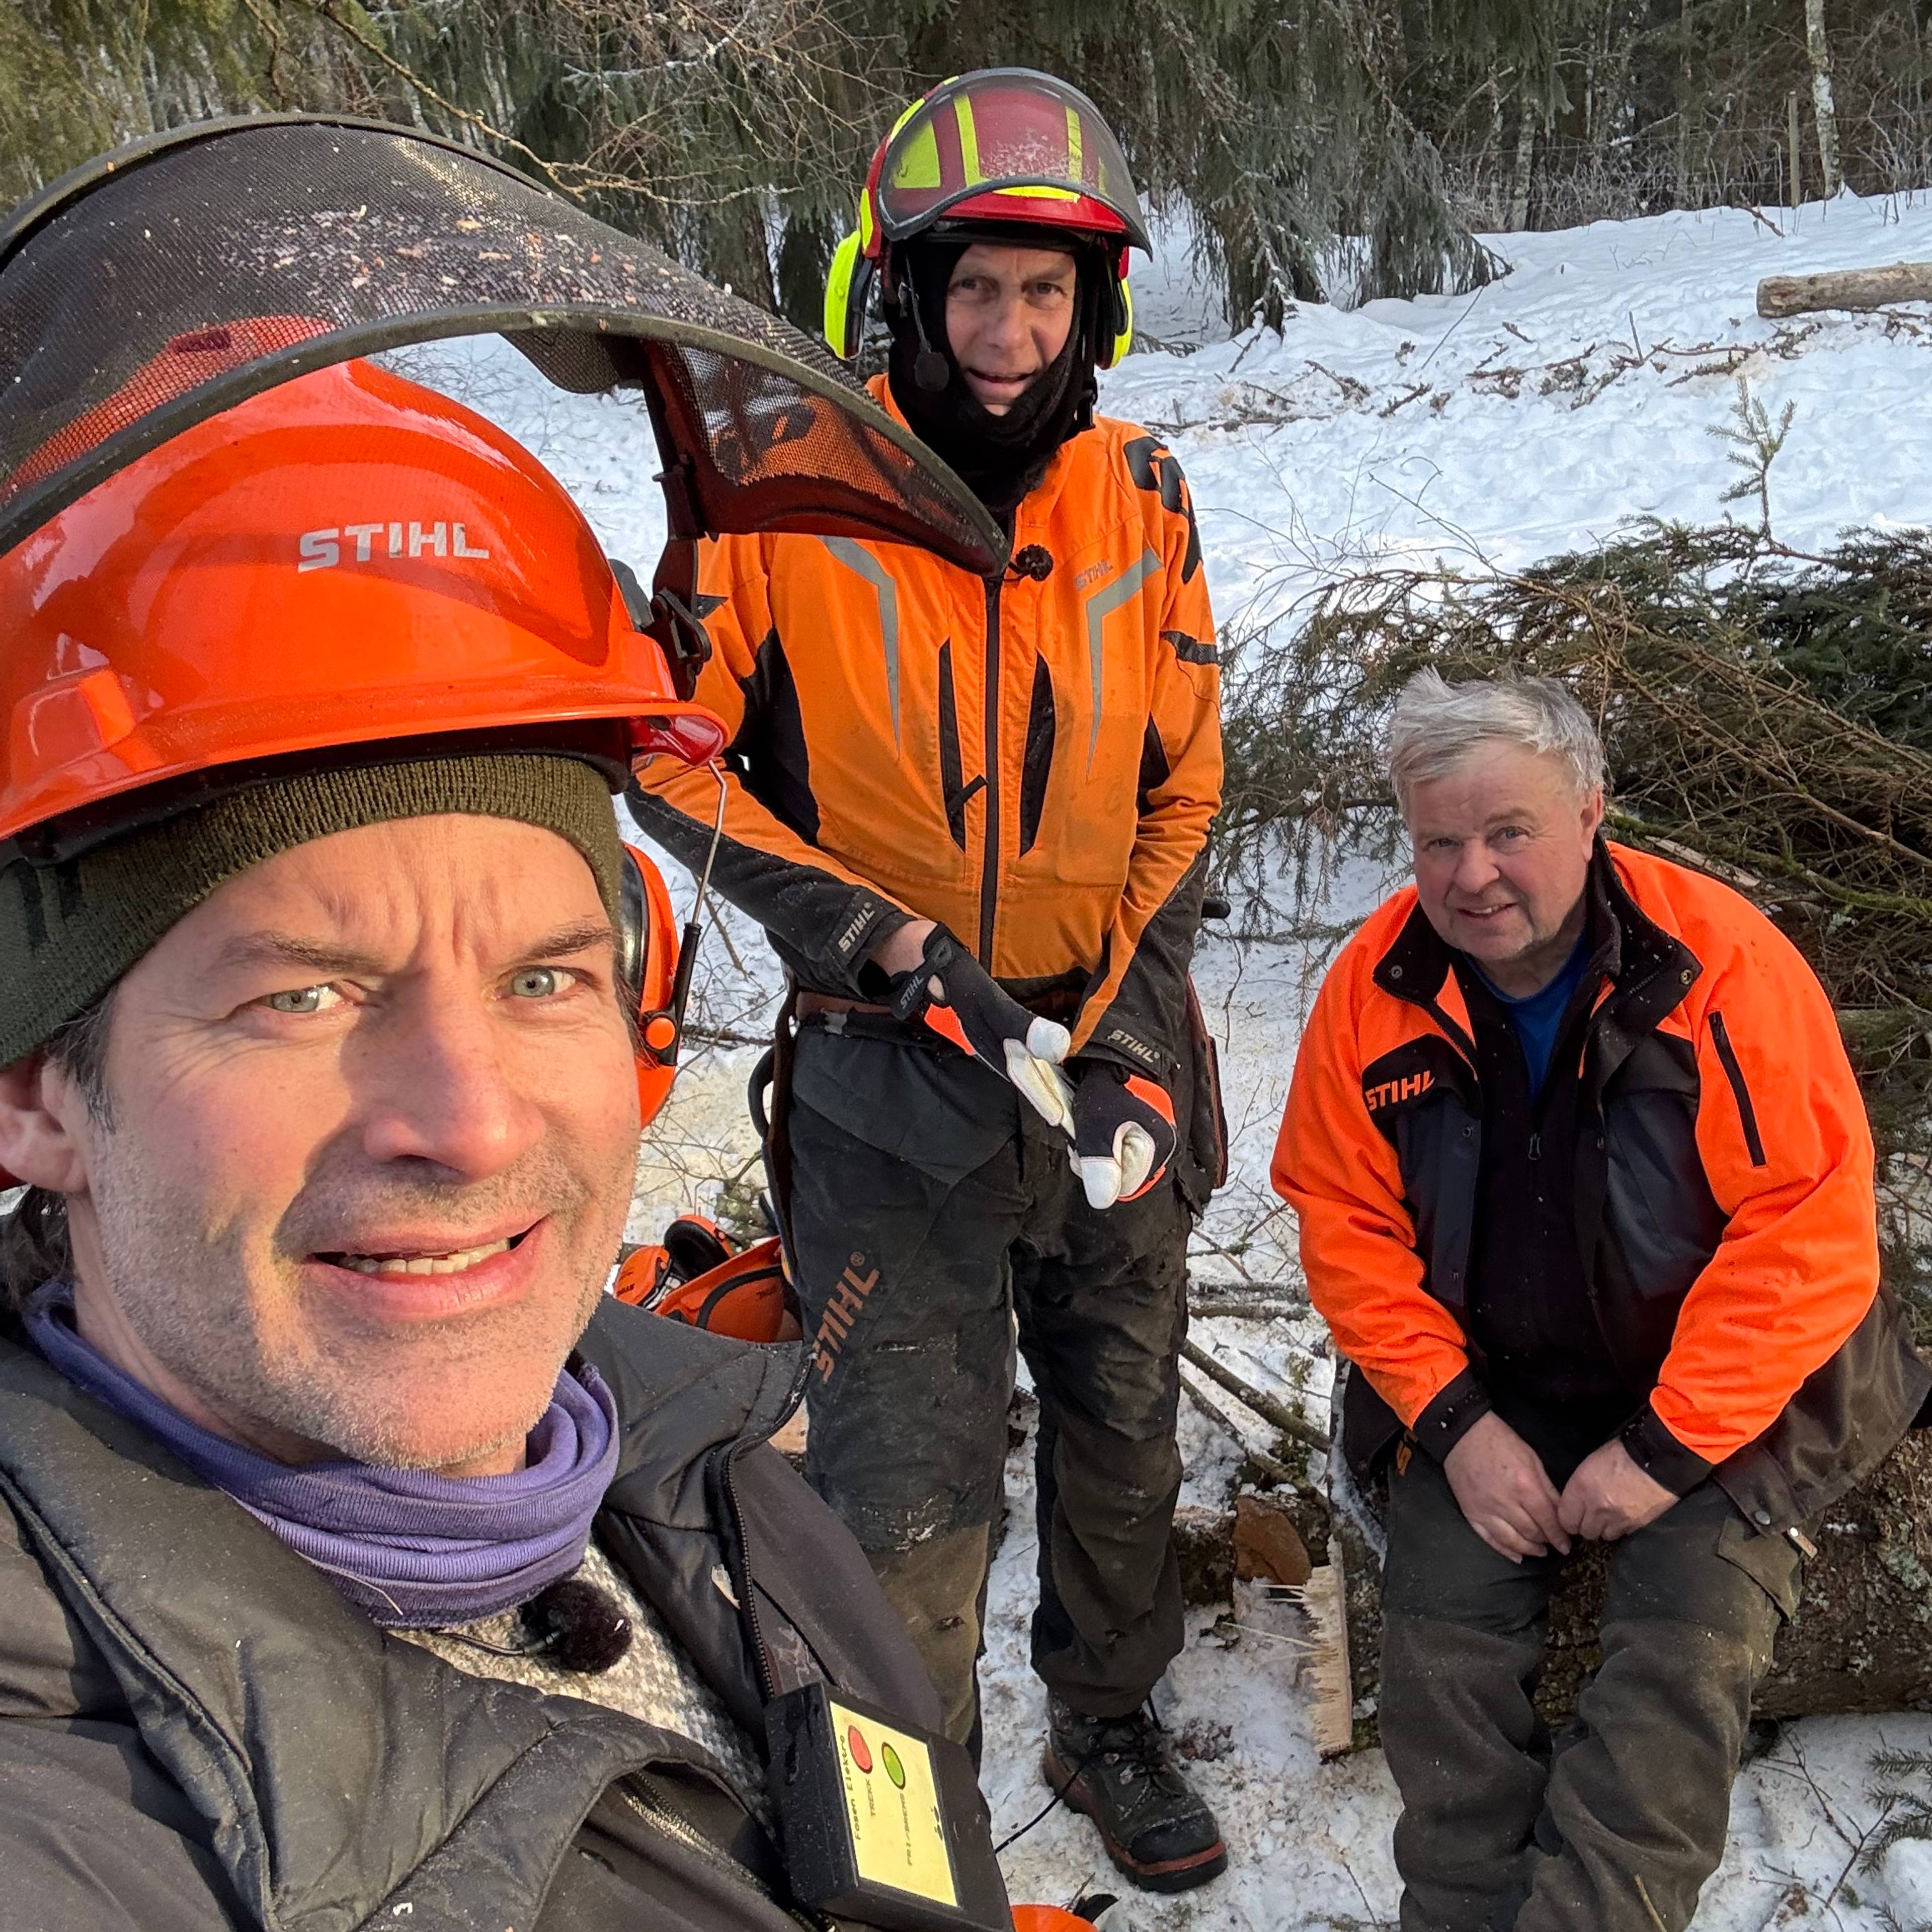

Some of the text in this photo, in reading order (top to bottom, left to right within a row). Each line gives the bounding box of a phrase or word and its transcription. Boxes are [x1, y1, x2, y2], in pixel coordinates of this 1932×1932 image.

[297, 521, 490, 573] STIHL
[1074, 558, 1113, 592] STIHL
[900, 975, 924, 1009] STIHL
[1365, 1070, 1435, 1111] STIHL
[840, 1735, 861, 1840] Fosen Elektro
